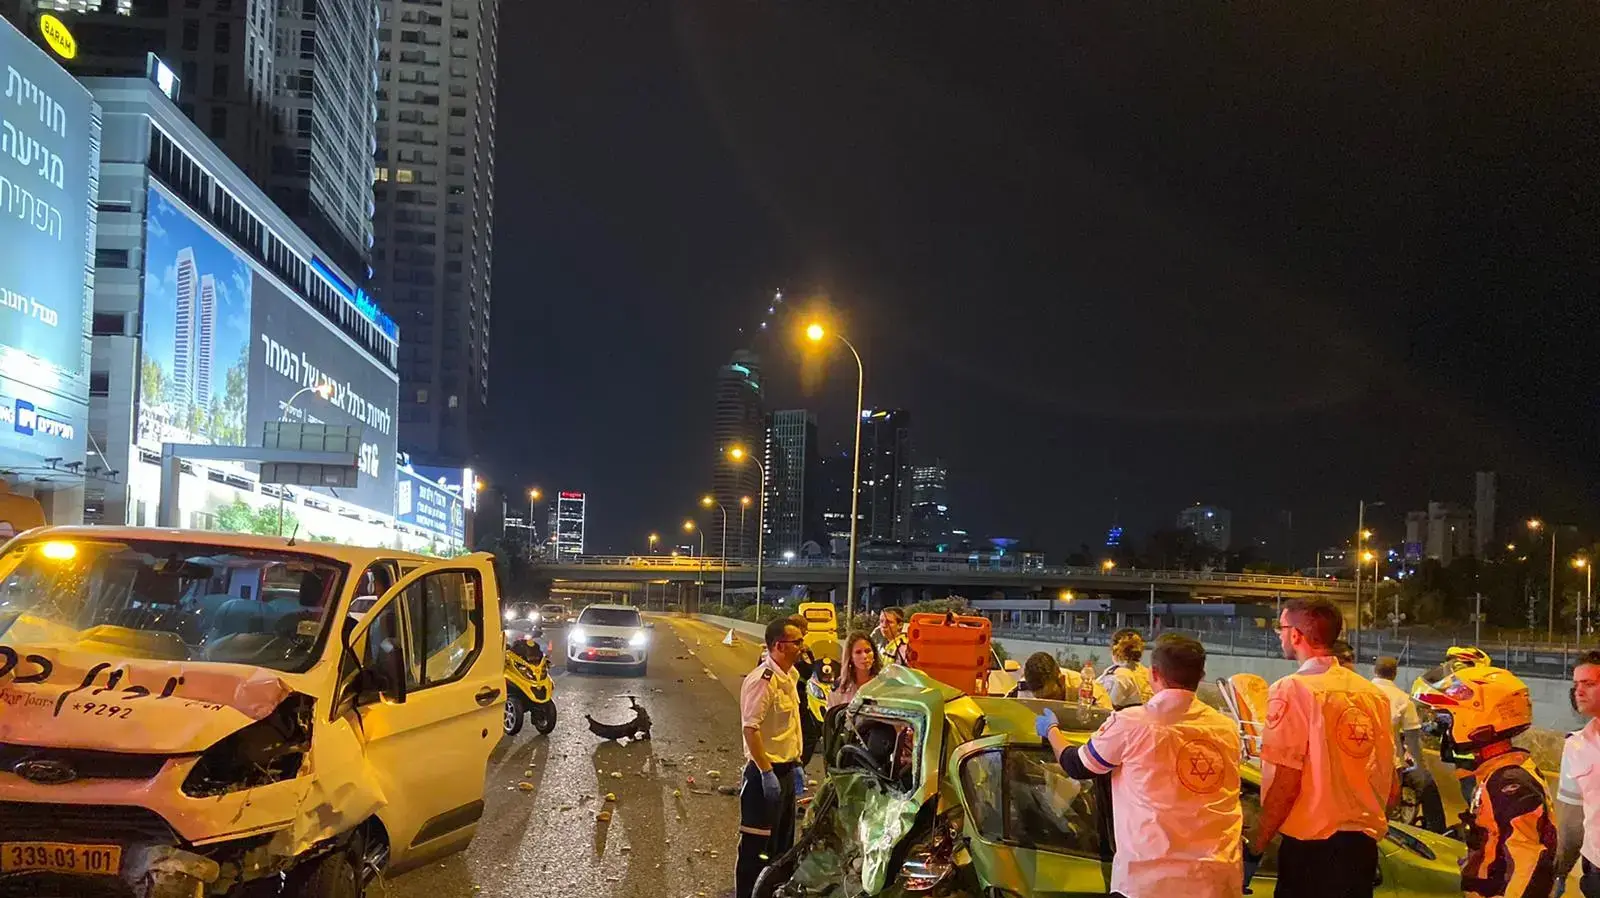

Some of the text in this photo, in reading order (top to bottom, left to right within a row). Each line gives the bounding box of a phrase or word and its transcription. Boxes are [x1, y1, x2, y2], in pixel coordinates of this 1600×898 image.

[44, 21, 72, 54] BARAM
[5, 64, 66, 140] חוויית
[2, 119, 64, 190] מגיעה
[261, 333, 299, 383] המחר
[302, 351, 319, 392] של
[347, 382, 366, 422] בתל
[367, 402, 391, 435] לחיות
